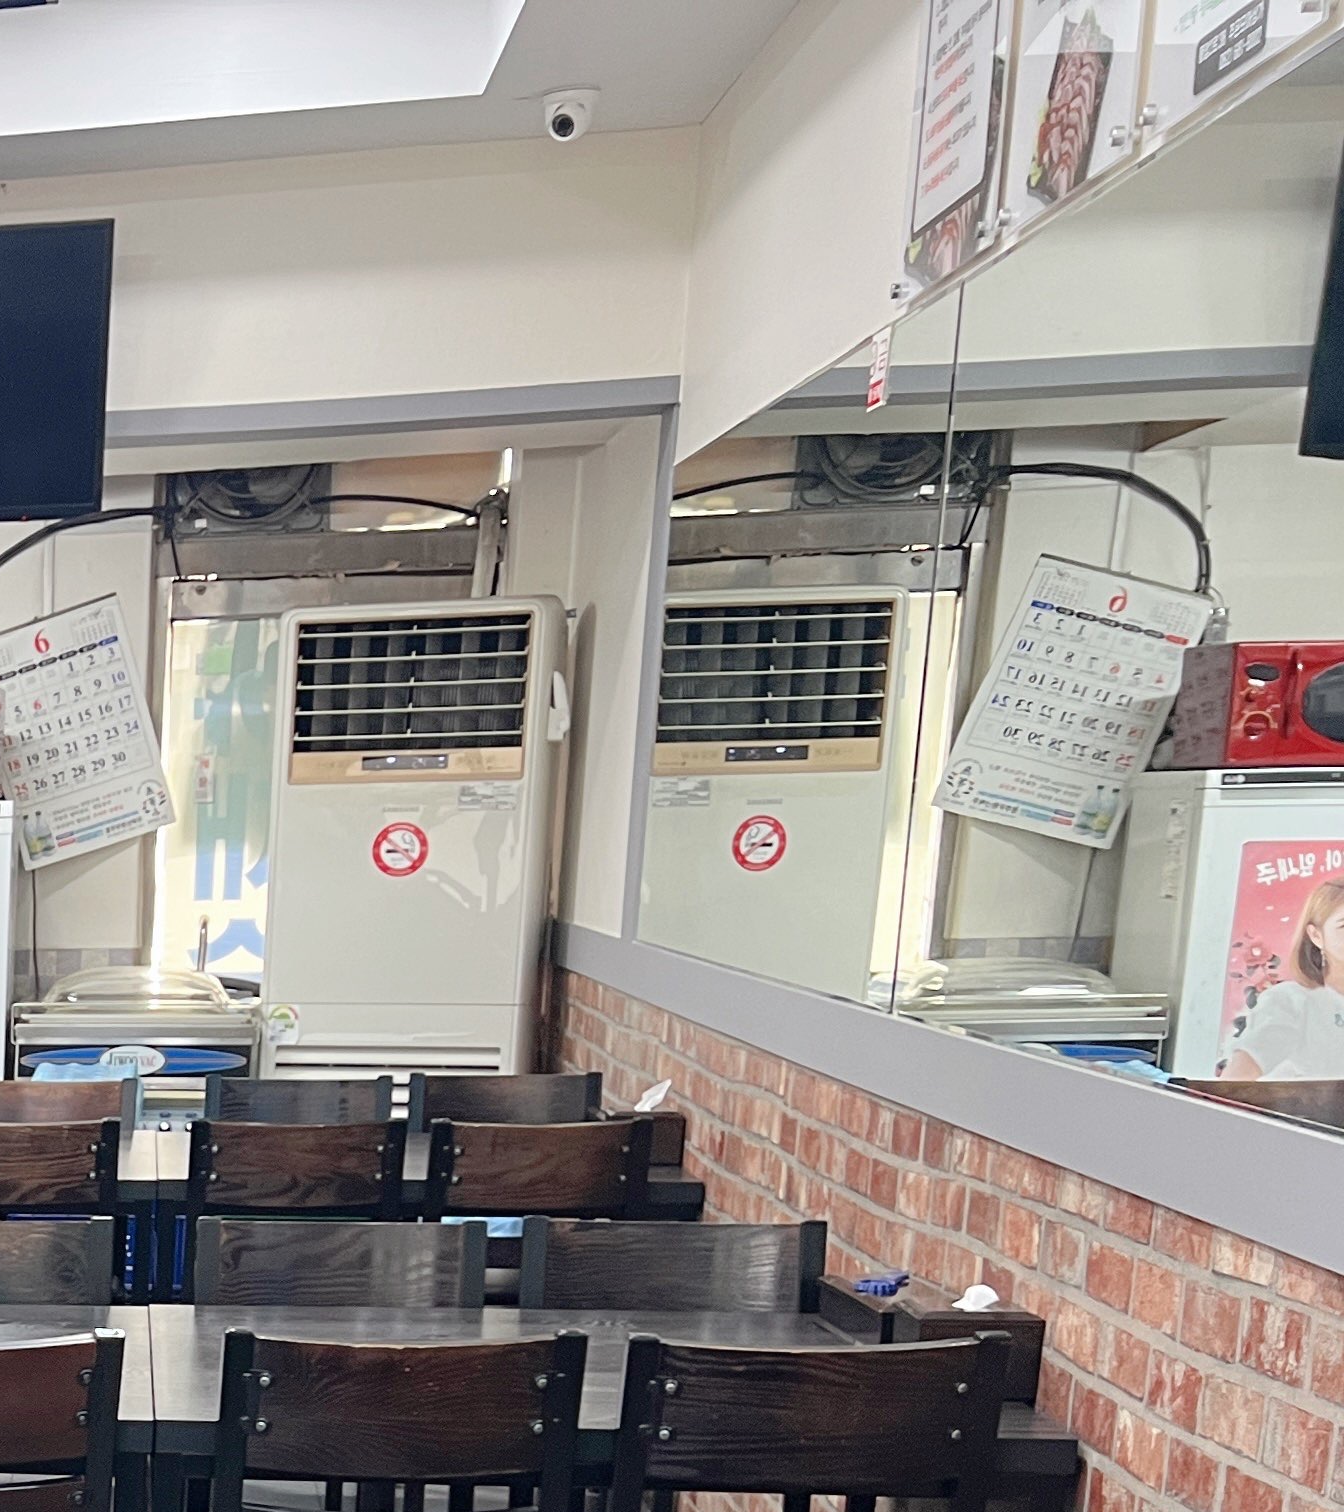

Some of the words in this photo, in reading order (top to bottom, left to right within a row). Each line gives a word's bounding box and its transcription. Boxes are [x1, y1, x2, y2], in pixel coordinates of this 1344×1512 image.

[34, 628, 50, 654] 6
[68, 661, 75, 671] 1
[88, 655, 96, 666] 2
[14, 706, 22, 716] 5
[33, 700, 42, 711] 6
[53, 692, 62, 704] 7
[73, 687, 82, 697] 8
[93, 679, 102, 690] 9
[112, 671, 126, 684] 10
[19, 729, 33, 742] 12
[38, 723, 52, 735] 13
[58, 717, 72, 729] 14
[78, 711, 92, 723] 15
[98, 704, 112, 716] 16
[118, 695, 132, 709] 17
[26, 754, 40, 766] 19
[45, 747, 59, 760] 20
[64, 741, 78, 754] 21
[84, 734, 98, 748] 22
[105, 727, 119, 741] 23
[124, 720, 139, 735] 24
[33, 778, 47, 791] 26
[52, 772, 65, 785] 27
[71, 765, 87, 779] 28
[91, 759, 106, 772] 29
[112, 751, 126, 764] 30
